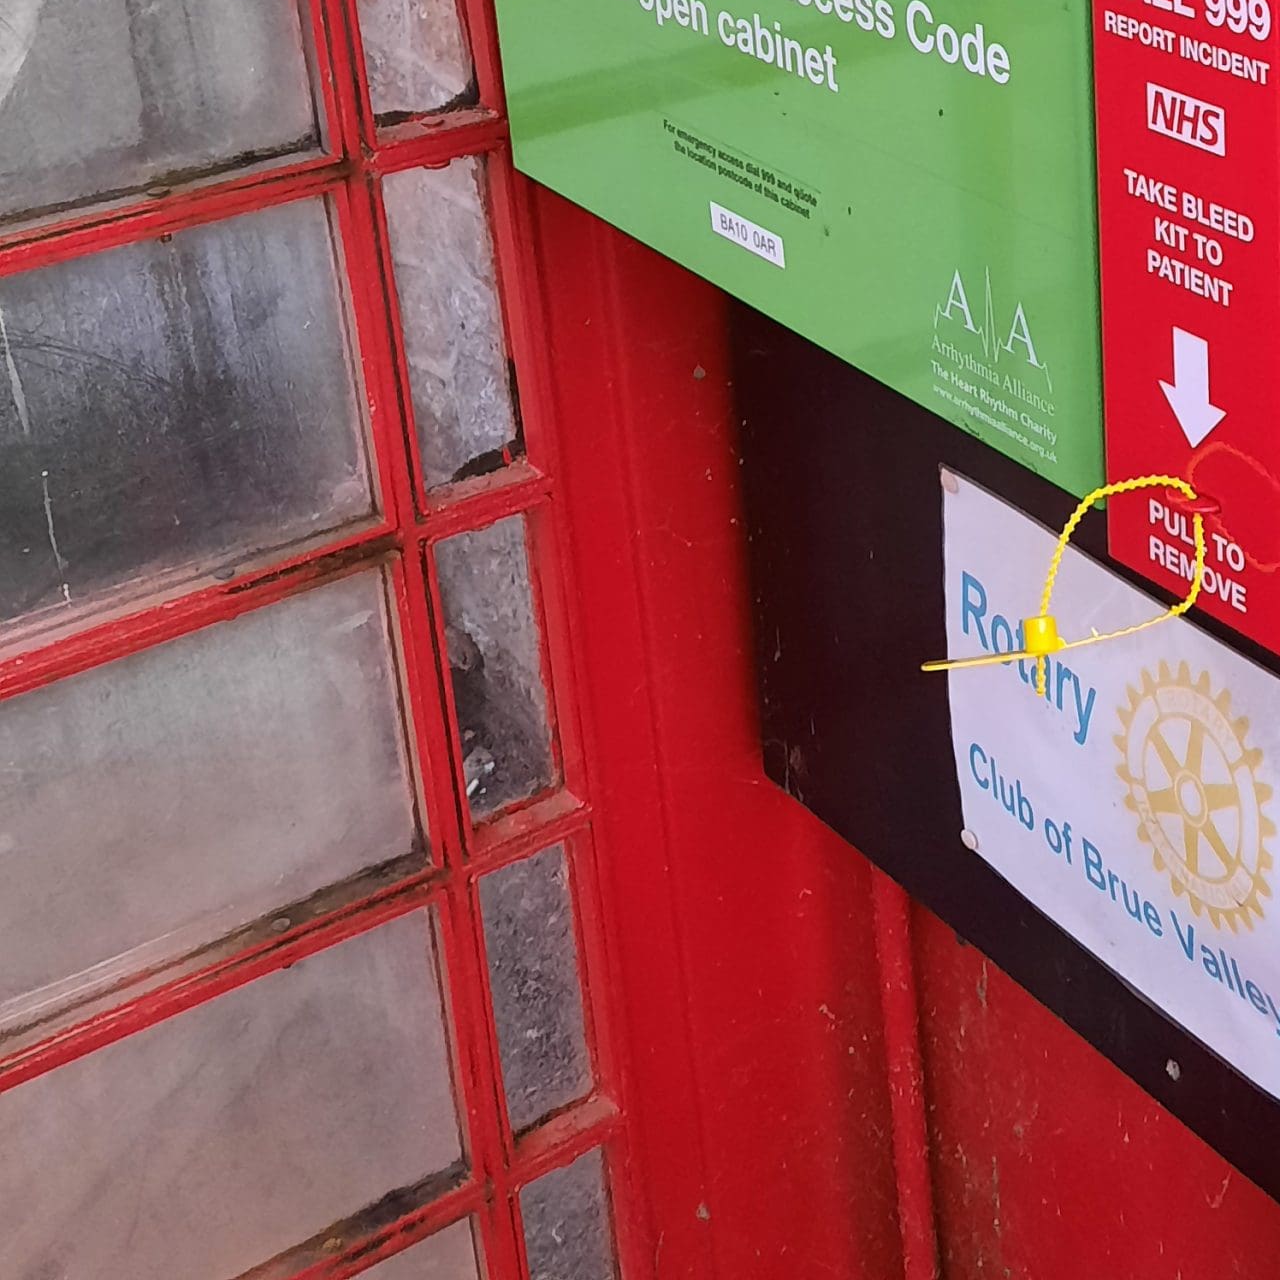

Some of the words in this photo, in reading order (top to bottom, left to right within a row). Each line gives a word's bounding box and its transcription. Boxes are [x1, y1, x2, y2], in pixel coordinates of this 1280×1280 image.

[717, 10, 839, 93] cabinet
[906, 0, 1010, 84] Code
[1104, 10, 1176, 53] REPORT
[1180, 34, 1270, 86] INCIDENT
[663, 119, 675, 134] For
[1151, 90, 1220, 146] NHS
[720, 213, 748, 241] BA10
[1123, 168, 1178, 213] TAKE
[1182, 192, 1254, 242] BLEED
[1154, 216, 1189, 253] KIT
[1192, 232, 1224, 266] TO
[1147, 249, 1233, 308] PATIENT
[941, 269, 979, 334] A
[1004, 302, 1040, 369] A
[931, 360, 949, 380] The
[951, 372, 978, 398] Heart
[980, 388, 1018, 421] Rhythm
[1021, 413, 1057, 445] Charity
[932, 335, 1000, 386] Arrhythmia
[1003, 374, 1055, 416] Alliance
[1149, 498, 1208, 553] PUL
[1212, 533, 1245, 572] TO
[1149, 535, 1247, 613] REMOVE
[969, 742, 1034, 833] Club
[1043, 816, 1074, 864] of
[1082, 838, 1164, 937] Brue
